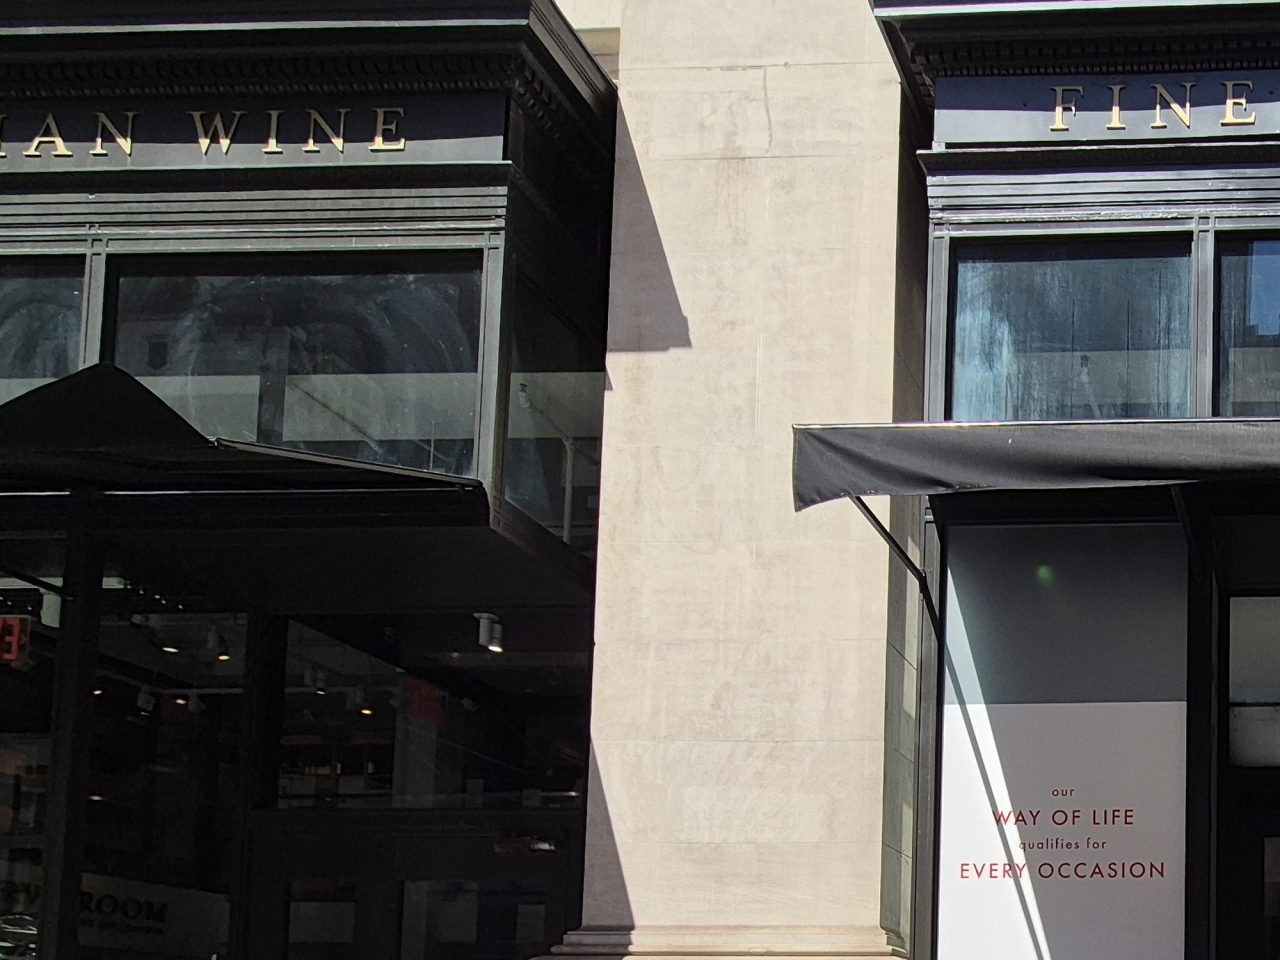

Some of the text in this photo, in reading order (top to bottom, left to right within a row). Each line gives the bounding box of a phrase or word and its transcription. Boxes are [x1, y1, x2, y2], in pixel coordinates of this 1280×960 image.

[1049, 79, 1256, 131] FINE
[186, 107, 406, 156] WINE
[1051, 788, 1075, 797] our
[992, 809, 1134, 826] WAY OF LIFE
[1019, 837, 1107, 852] qualifies for
[960, 861, 1165, 879] EVERY OCCASION
